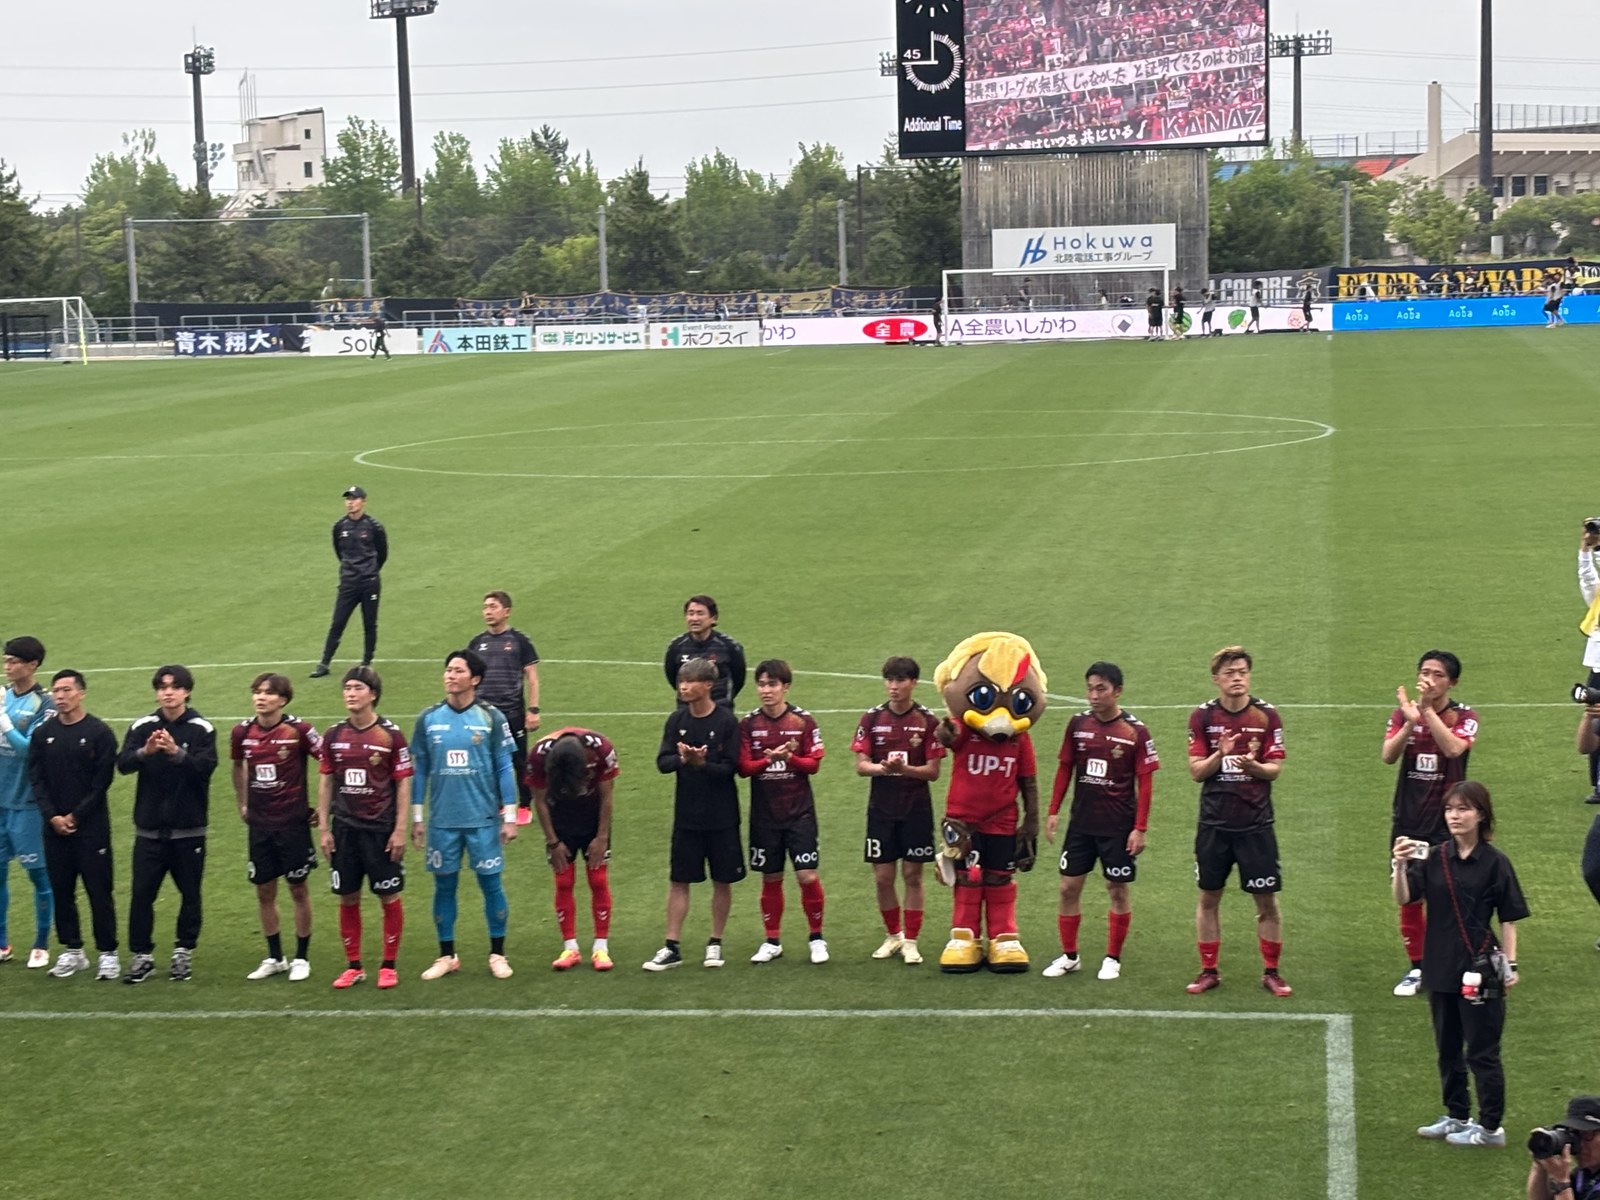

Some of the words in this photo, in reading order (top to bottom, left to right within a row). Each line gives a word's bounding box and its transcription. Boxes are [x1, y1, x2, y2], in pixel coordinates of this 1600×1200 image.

[903, 49, 921, 59] 45
[903, 116, 941, 132] Additional
[943, 115, 962, 131] Time
[1053, 232, 1153, 250] Hokuwa
[1345, 309, 1369, 321] Aoba
[1396, 307, 1420, 319] Aoba
[1448, 305, 1473, 318] Aoba
[1491, 304, 1516, 317] Aoba
[762, 324, 796, 341] かわ
[875, 322, 915, 337] 全農
[942, 316, 1077, 336] A全農いしかわ
[176, 329, 271, 354] 青木翔大
[457, 334, 528, 351] 本田鉄工
[447, 752, 466, 765] STS
[967, 753, 1016, 778] UP-T
[1088, 761, 1104, 775] STS
[347, 771, 364, 783] STS
[866, 838, 881, 858] 13
[906, 846, 933, 857] AOC
[751, 847, 766, 867] 25
[795, 852, 818, 864] AOC
[1106, 866, 1132, 877] AOC
[373, 876, 400, 890] AOC
[1246, 876, 1276, 888] AOC
